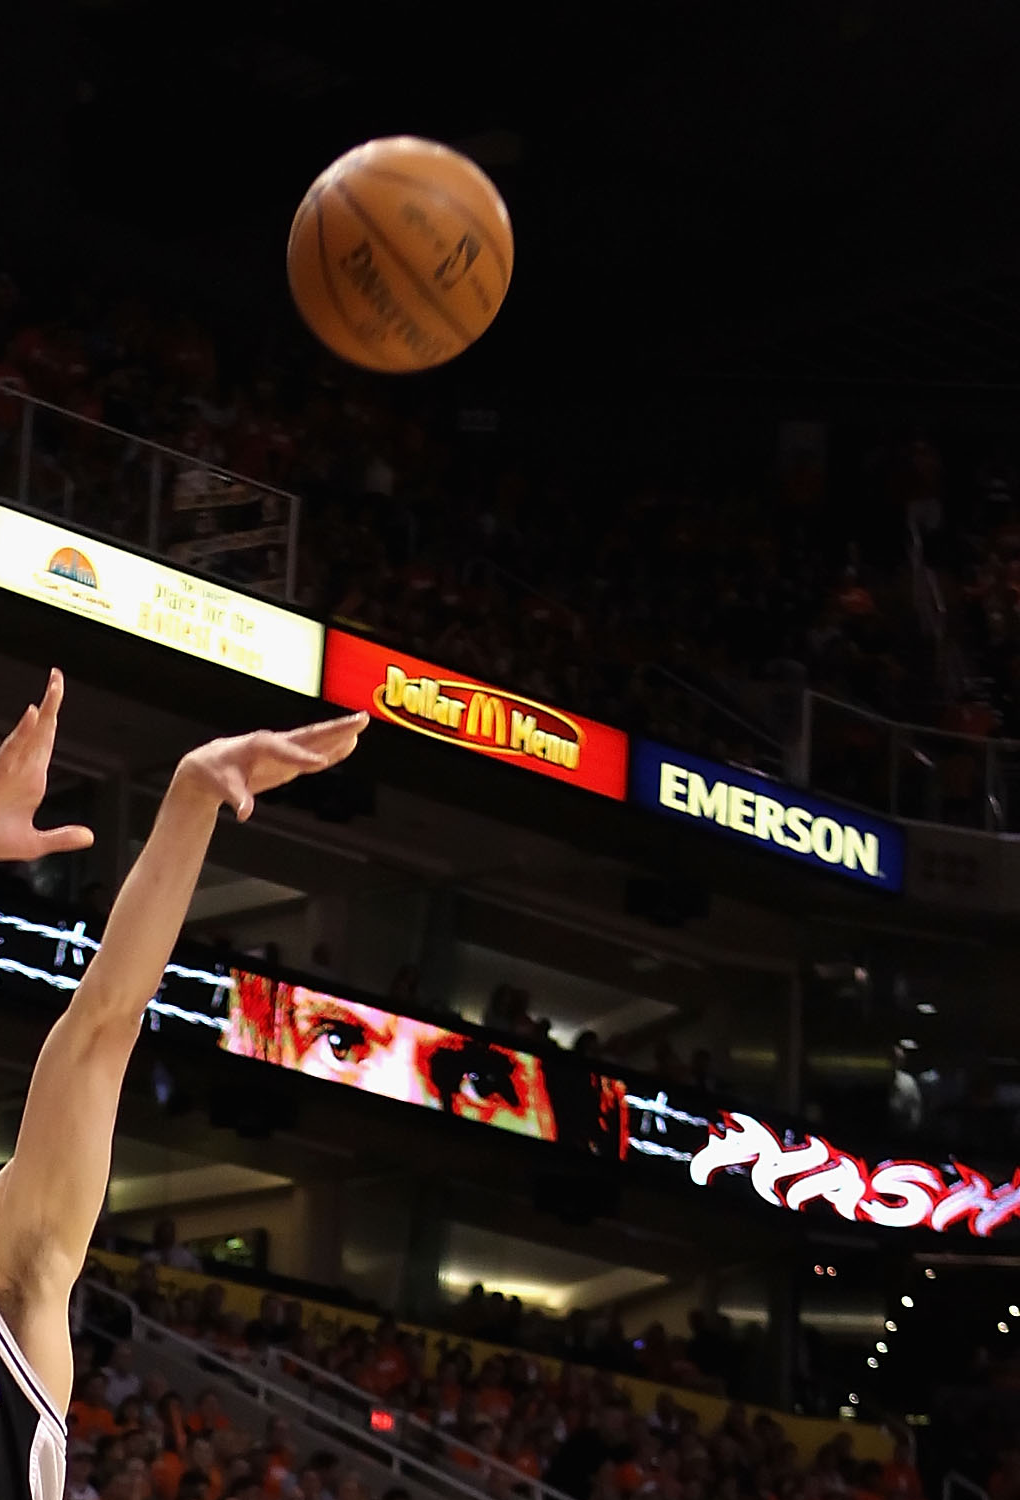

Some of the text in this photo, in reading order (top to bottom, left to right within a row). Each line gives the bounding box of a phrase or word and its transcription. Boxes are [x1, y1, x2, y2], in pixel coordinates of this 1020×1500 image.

[385, 663, 467, 728] Dollar
[510, 709, 580, 771] Menu
[660, 761, 880, 877] EMERSON
